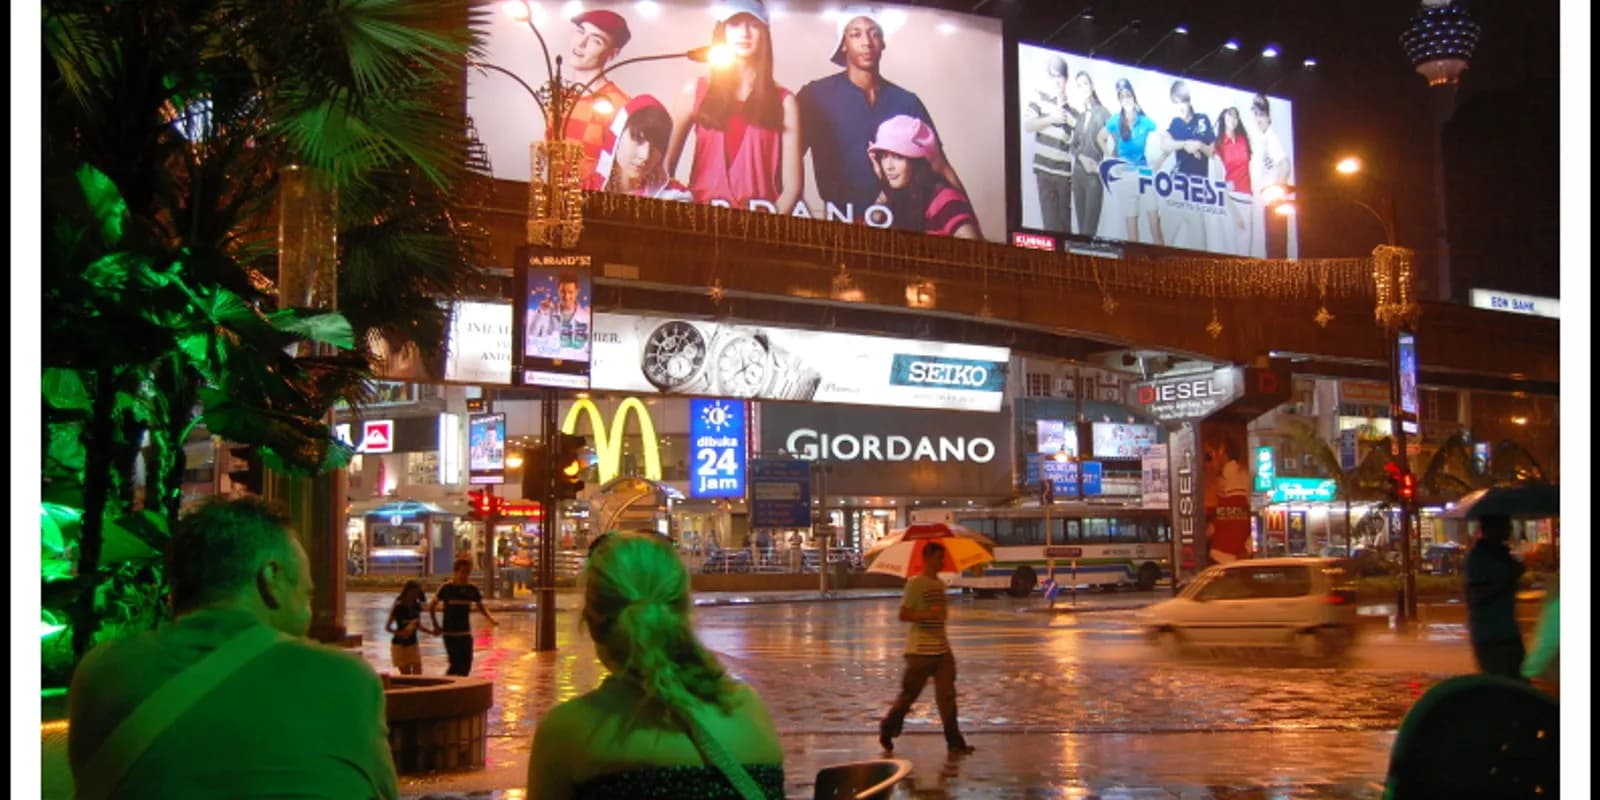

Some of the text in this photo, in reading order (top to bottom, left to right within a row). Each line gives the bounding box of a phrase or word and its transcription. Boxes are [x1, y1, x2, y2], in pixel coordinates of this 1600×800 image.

[1138, 168, 1227, 207] FOREST
[908, 361, 987, 387] SEIKO
[1137, 381, 1225, 405] DIESEL
[697, 436, 738, 448] dibuka
[786, 428, 995, 463] GIORDANO
[697, 448, 738, 475] 24
[699, 476, 738, 493] jam
